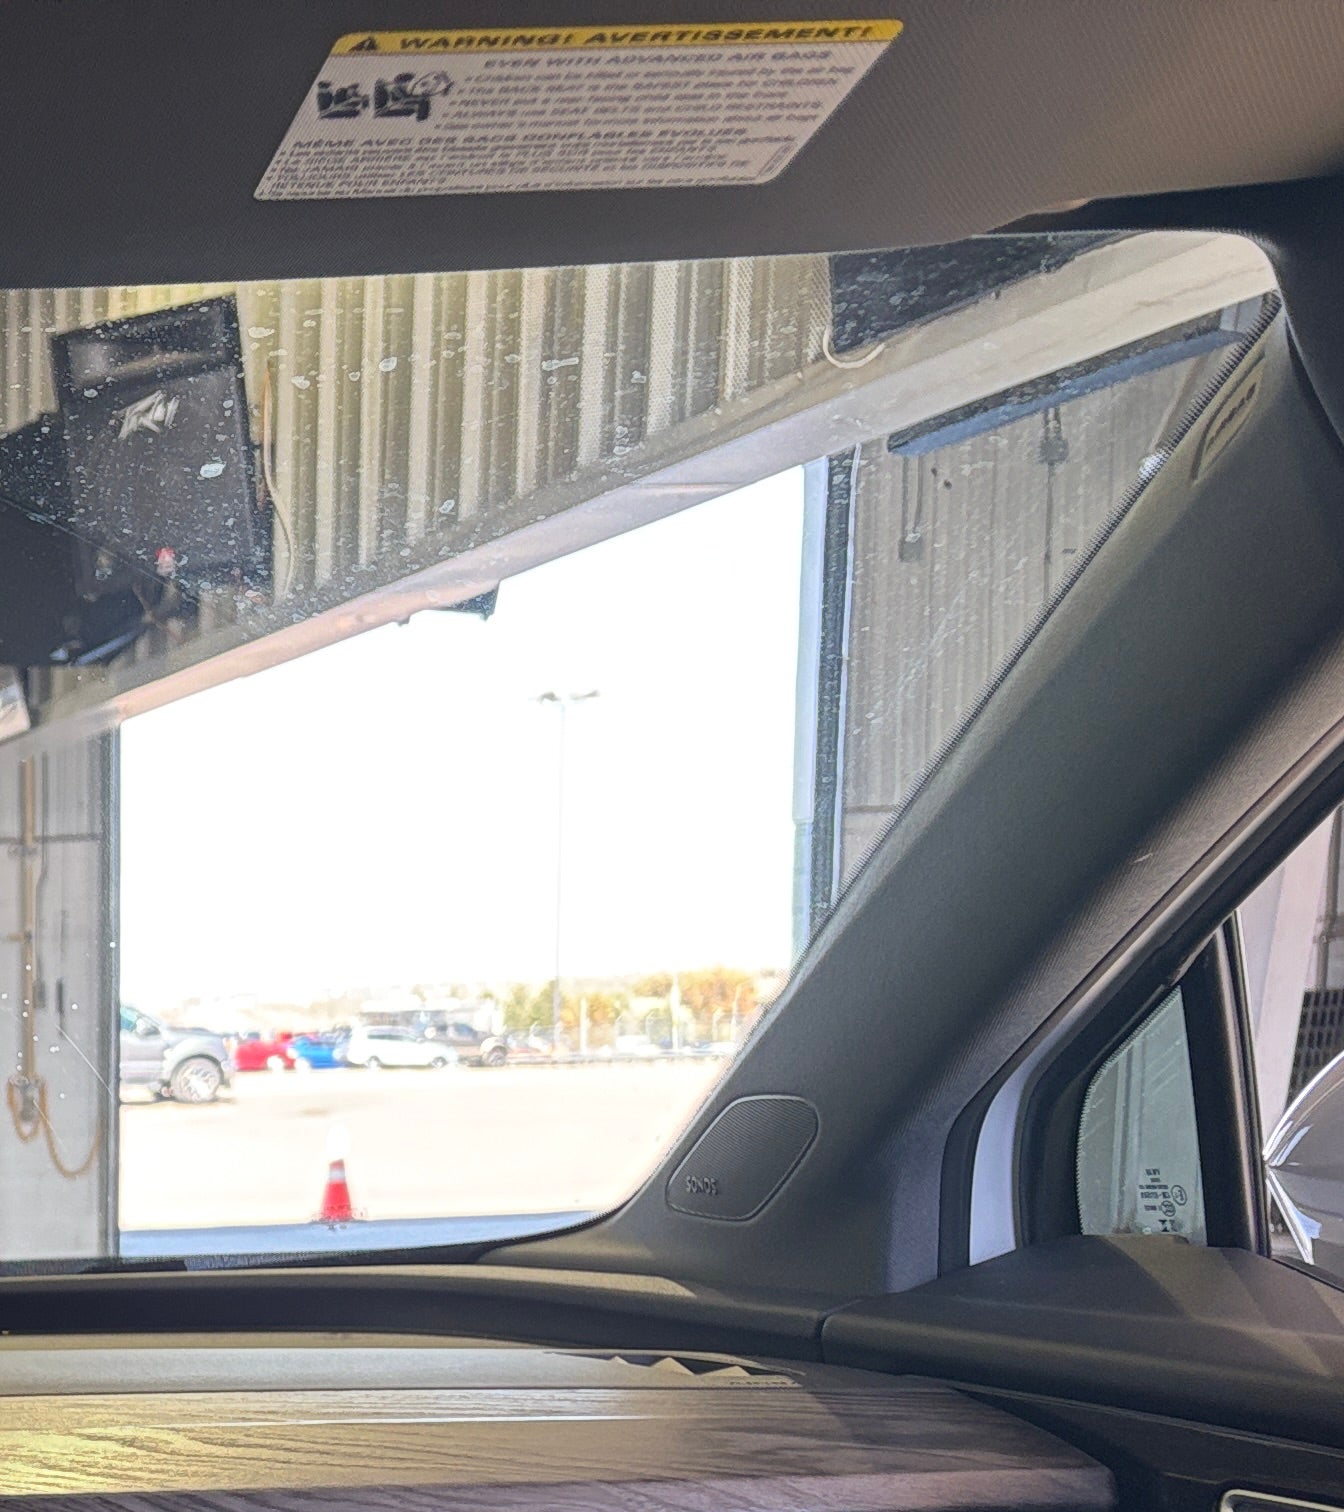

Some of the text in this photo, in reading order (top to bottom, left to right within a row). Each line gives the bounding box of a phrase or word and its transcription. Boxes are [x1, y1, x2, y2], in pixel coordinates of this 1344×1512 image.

[399, 26, 873, 49] WARNING! AVERTISSEMENT!
[686, 1175, 718, 1195] SONOS
